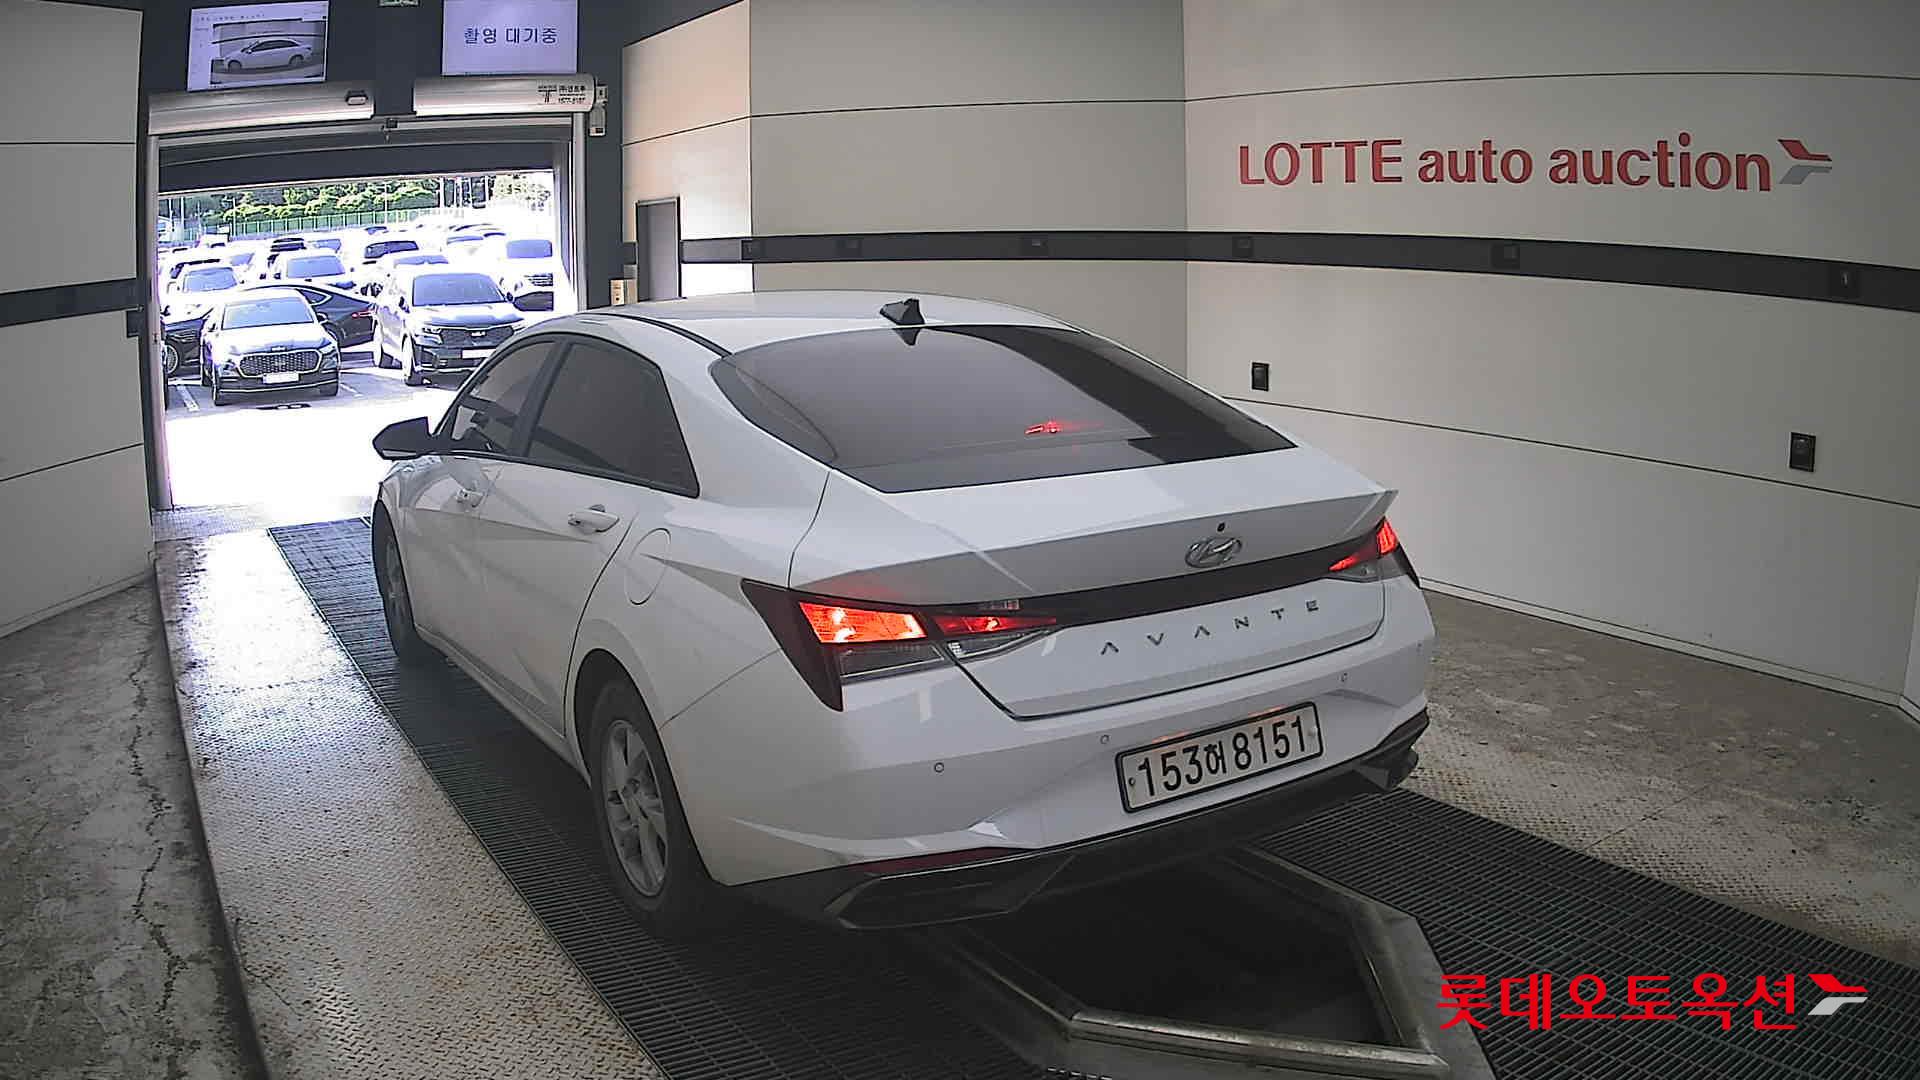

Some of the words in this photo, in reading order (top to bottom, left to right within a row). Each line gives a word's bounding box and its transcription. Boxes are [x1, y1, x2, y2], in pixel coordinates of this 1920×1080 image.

[464, 28, 498, 44] 촬영
[506, 27, 558, 44] 대기중
[1239, 139, 1403, 186] LOTTE
[1418, 139, 1533, 184] auto
[1549, 132, 1772, 192] auction
[1100, 600, 1320, 656] AVANTE
